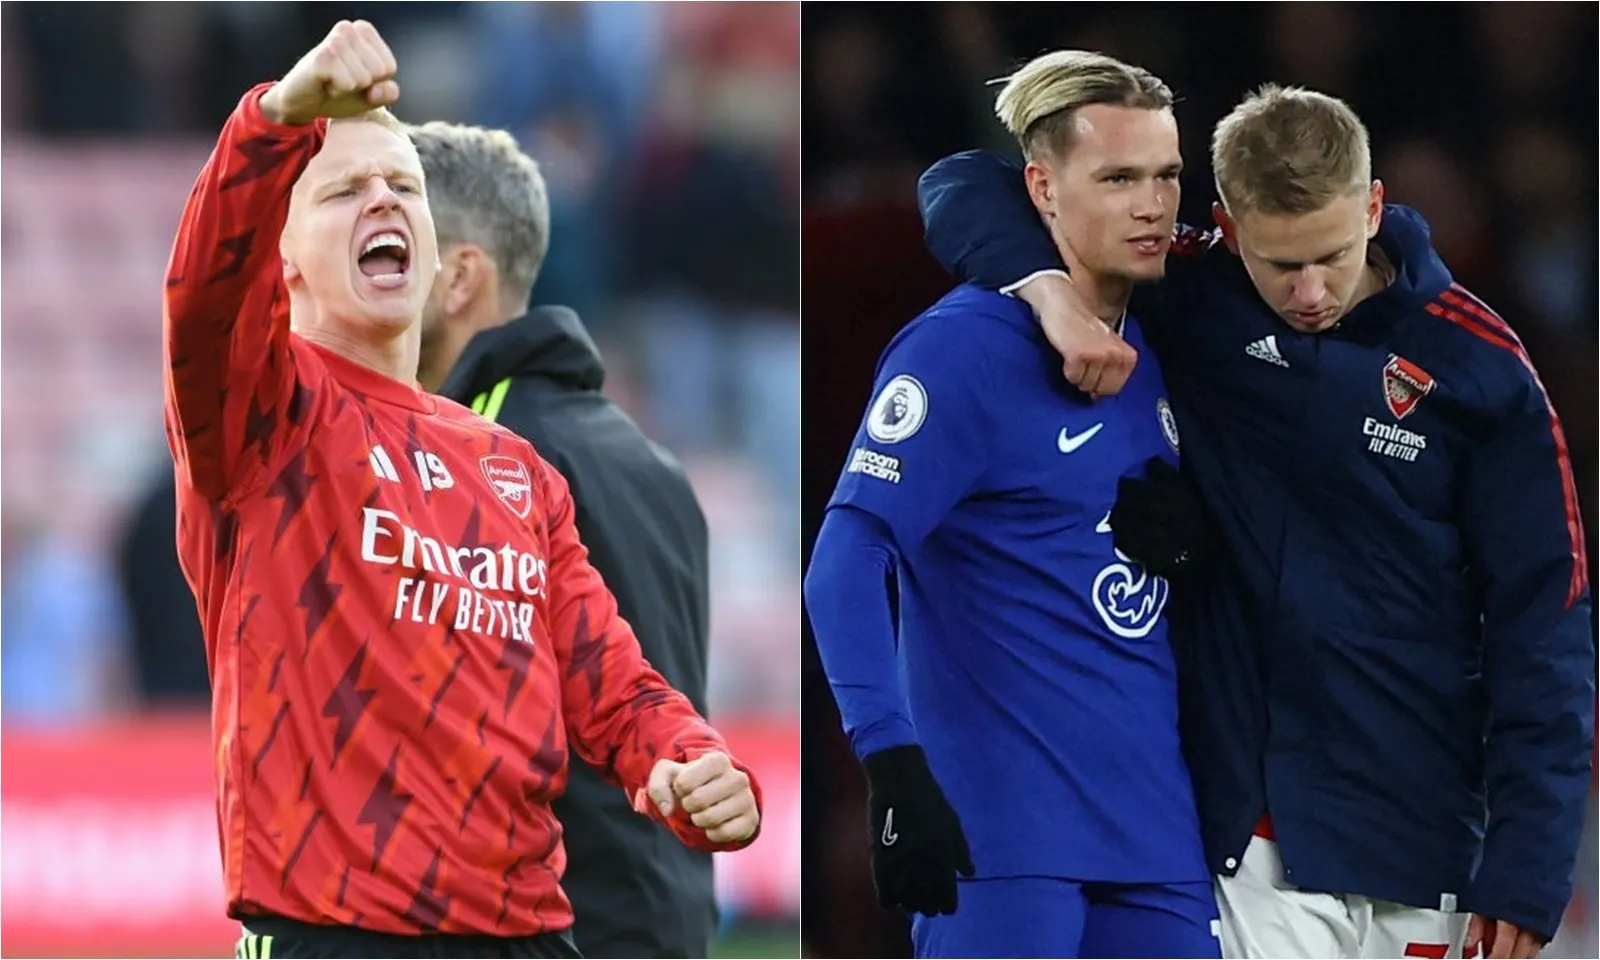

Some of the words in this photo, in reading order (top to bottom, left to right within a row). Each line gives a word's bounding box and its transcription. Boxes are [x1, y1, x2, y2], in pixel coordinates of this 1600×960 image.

[1387, 363, 1429, 392] Arsenal
[1384, 441, 1419, 462] BETTER
[414, 450, 455, 491] 19
[488, 465, 524, 479] Arsenal
[394, 577, 449, 626] FLY
[453, 587, 535, 645] BETTER
